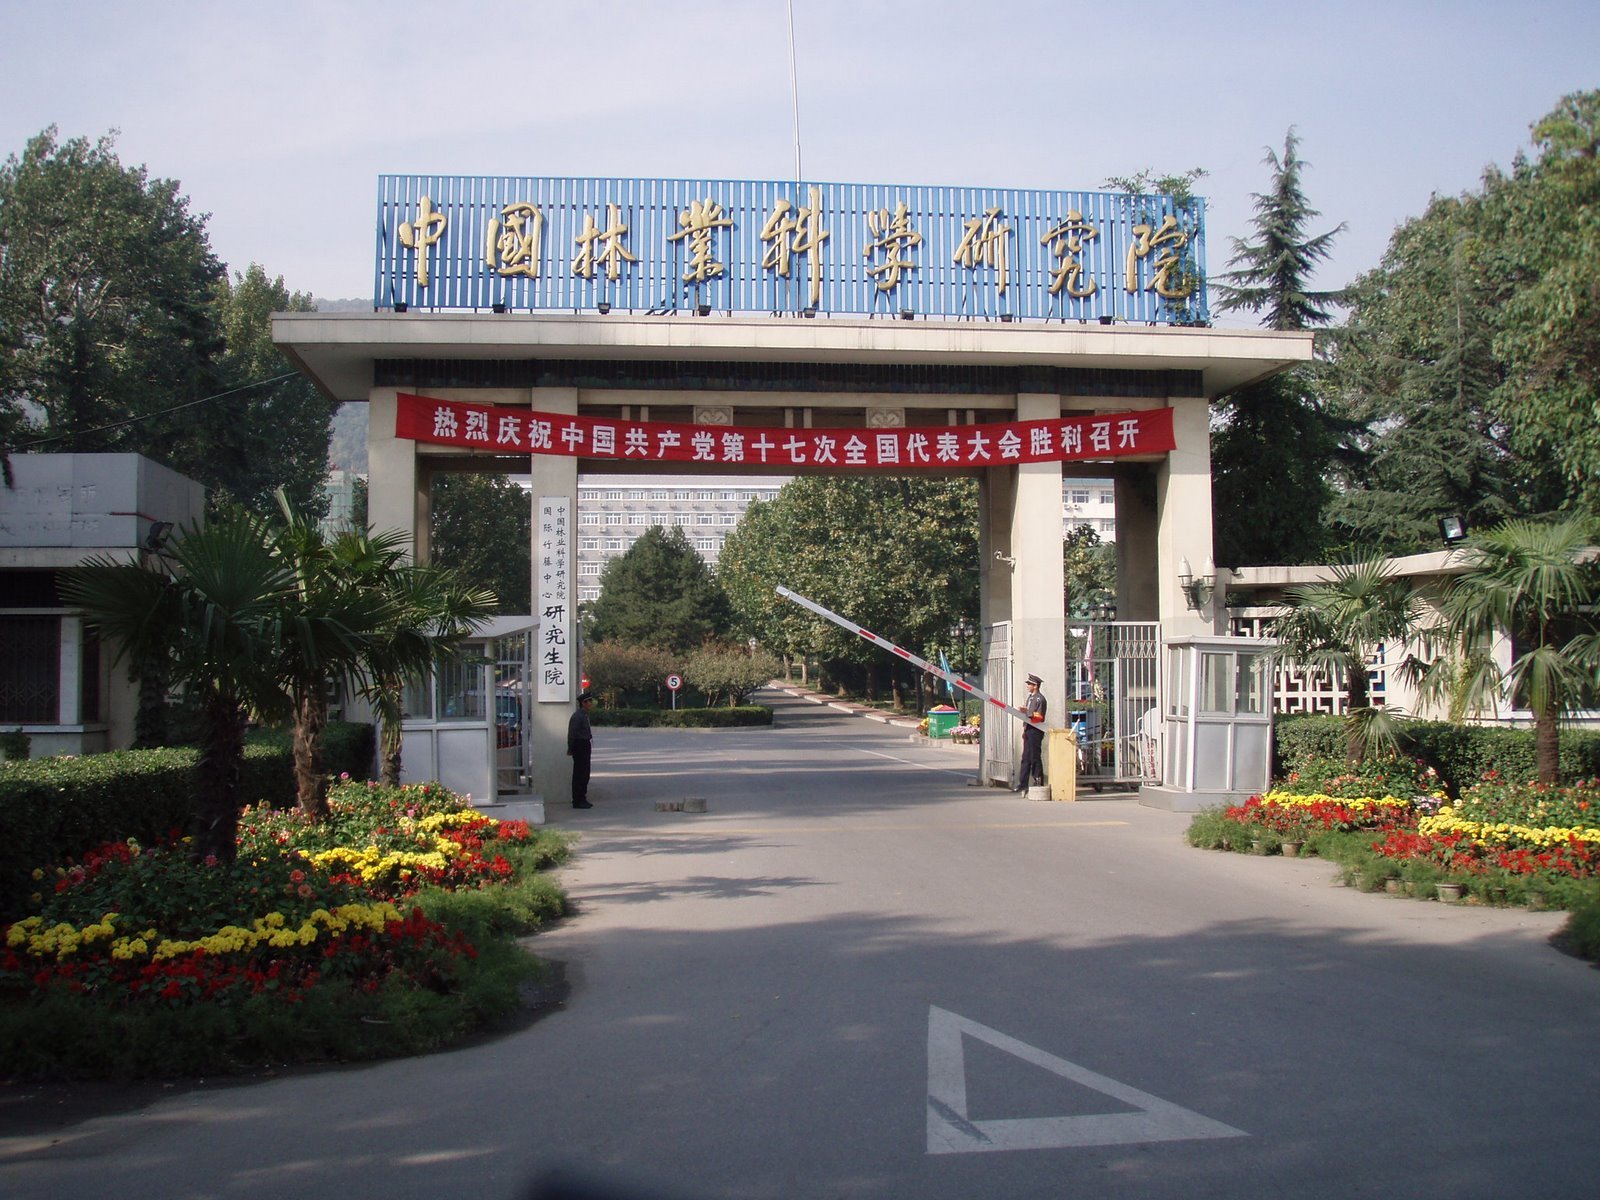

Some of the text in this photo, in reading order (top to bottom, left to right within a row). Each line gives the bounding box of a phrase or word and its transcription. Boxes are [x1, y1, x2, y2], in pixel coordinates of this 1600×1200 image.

[432, 406, 1139, 464] 热烈庆祝中国共产党第十七次全国代表大会胜利召开
[555, 506, 566, 600] 中国林业科学研究院
[543, 604, 566, 686] 研究生院
[670, 677, 678, 687] 5
